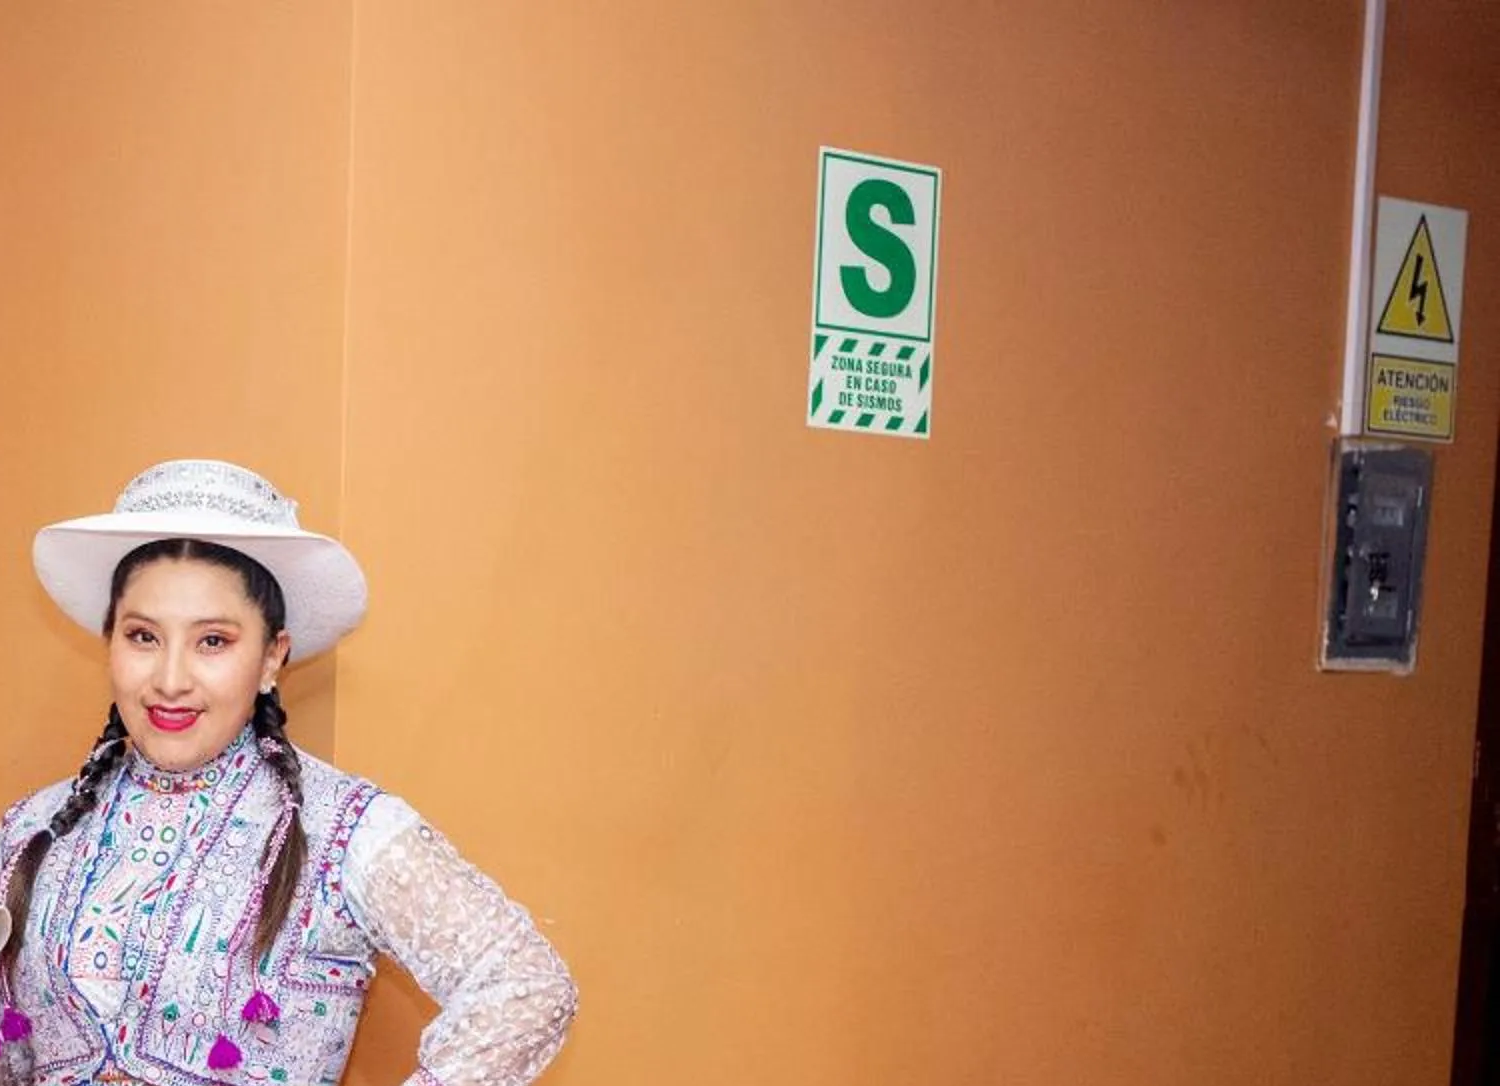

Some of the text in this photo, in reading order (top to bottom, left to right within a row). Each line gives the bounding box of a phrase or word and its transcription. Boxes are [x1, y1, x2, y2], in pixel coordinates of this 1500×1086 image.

[839, 178, 917, 318] S
[831, 355, 913, 379] ZONA SEGURA
[846, 375, 898, 394] EN CASO
[1377, 368, 1449, 393] ATENCIÓN
[839, 391, 903, 412] DE SISMOS
